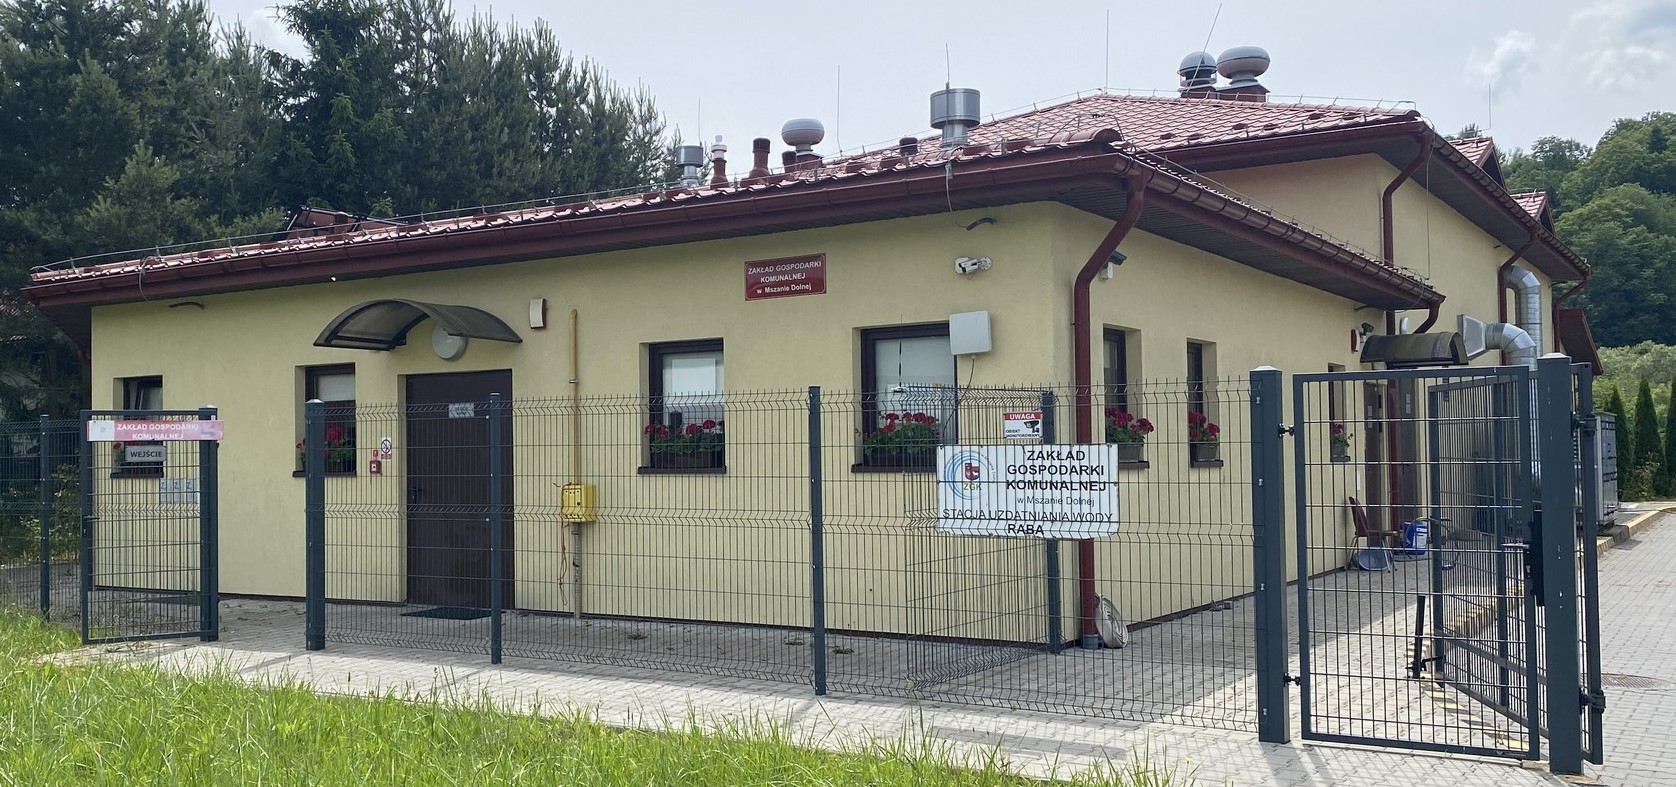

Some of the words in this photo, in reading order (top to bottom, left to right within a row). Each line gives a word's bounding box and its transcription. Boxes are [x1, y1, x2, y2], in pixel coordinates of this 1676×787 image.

[748, 266, 774, 275] ZAKŁAD
[776, 261, 822, 271] GOSPODARKI
[760, 273, 806, 283] KOMUNALNEJ
[765, 286, 789, 294] Mszanie
[791, 283, 812, 291] Dolnej
[130, 449, 163, 458] WEJŚCIE
[1026, 450, 1085, 461] ZAKŁAD
[1007, 465, 1104, 476] GOSPODARKI
[963, 483, 982, 491] ZGK
[1006, 480, 1107, 492] KOMUNALNEJ
[1026, 496, 1063, 505] Mszanie
[1066, 496, 1095, 507] Dolnej
[942, 509, 989, 520] STACJA
[989, 510, 1070, 522] UZDATNIANIA
[1073, 512, 1114, 523] WODY
[1007, 524, 1044, 535] RABA
